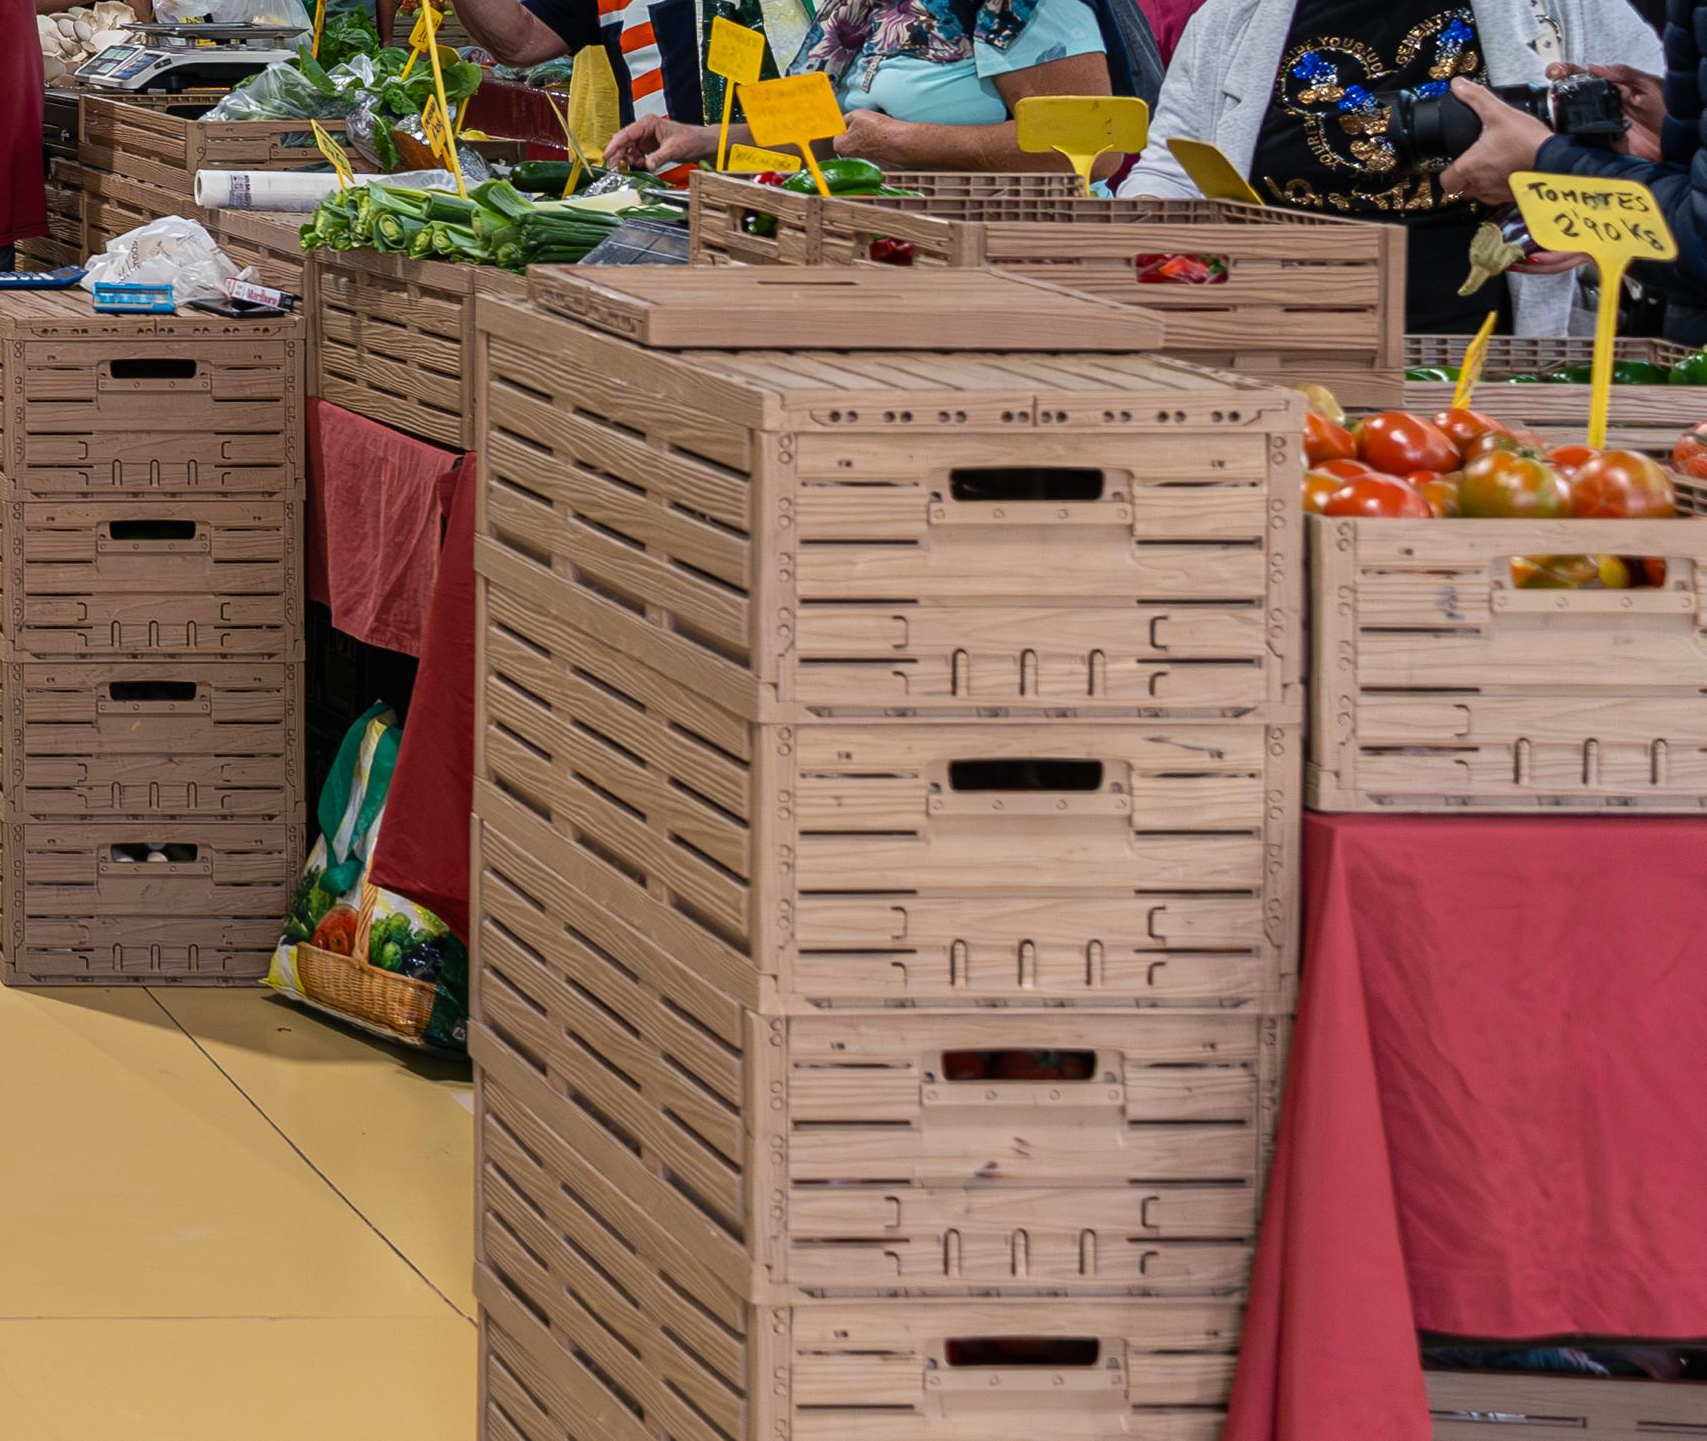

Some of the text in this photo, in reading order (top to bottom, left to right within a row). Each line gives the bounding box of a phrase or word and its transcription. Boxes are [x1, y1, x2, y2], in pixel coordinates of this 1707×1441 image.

[1317, 35, 1363, 53] YOUR
[1527, 181, 1649, 213] TOMATES
[1553, 209, 1622, 241] 2'90
[245, 287, 278, 305] Marlboro
